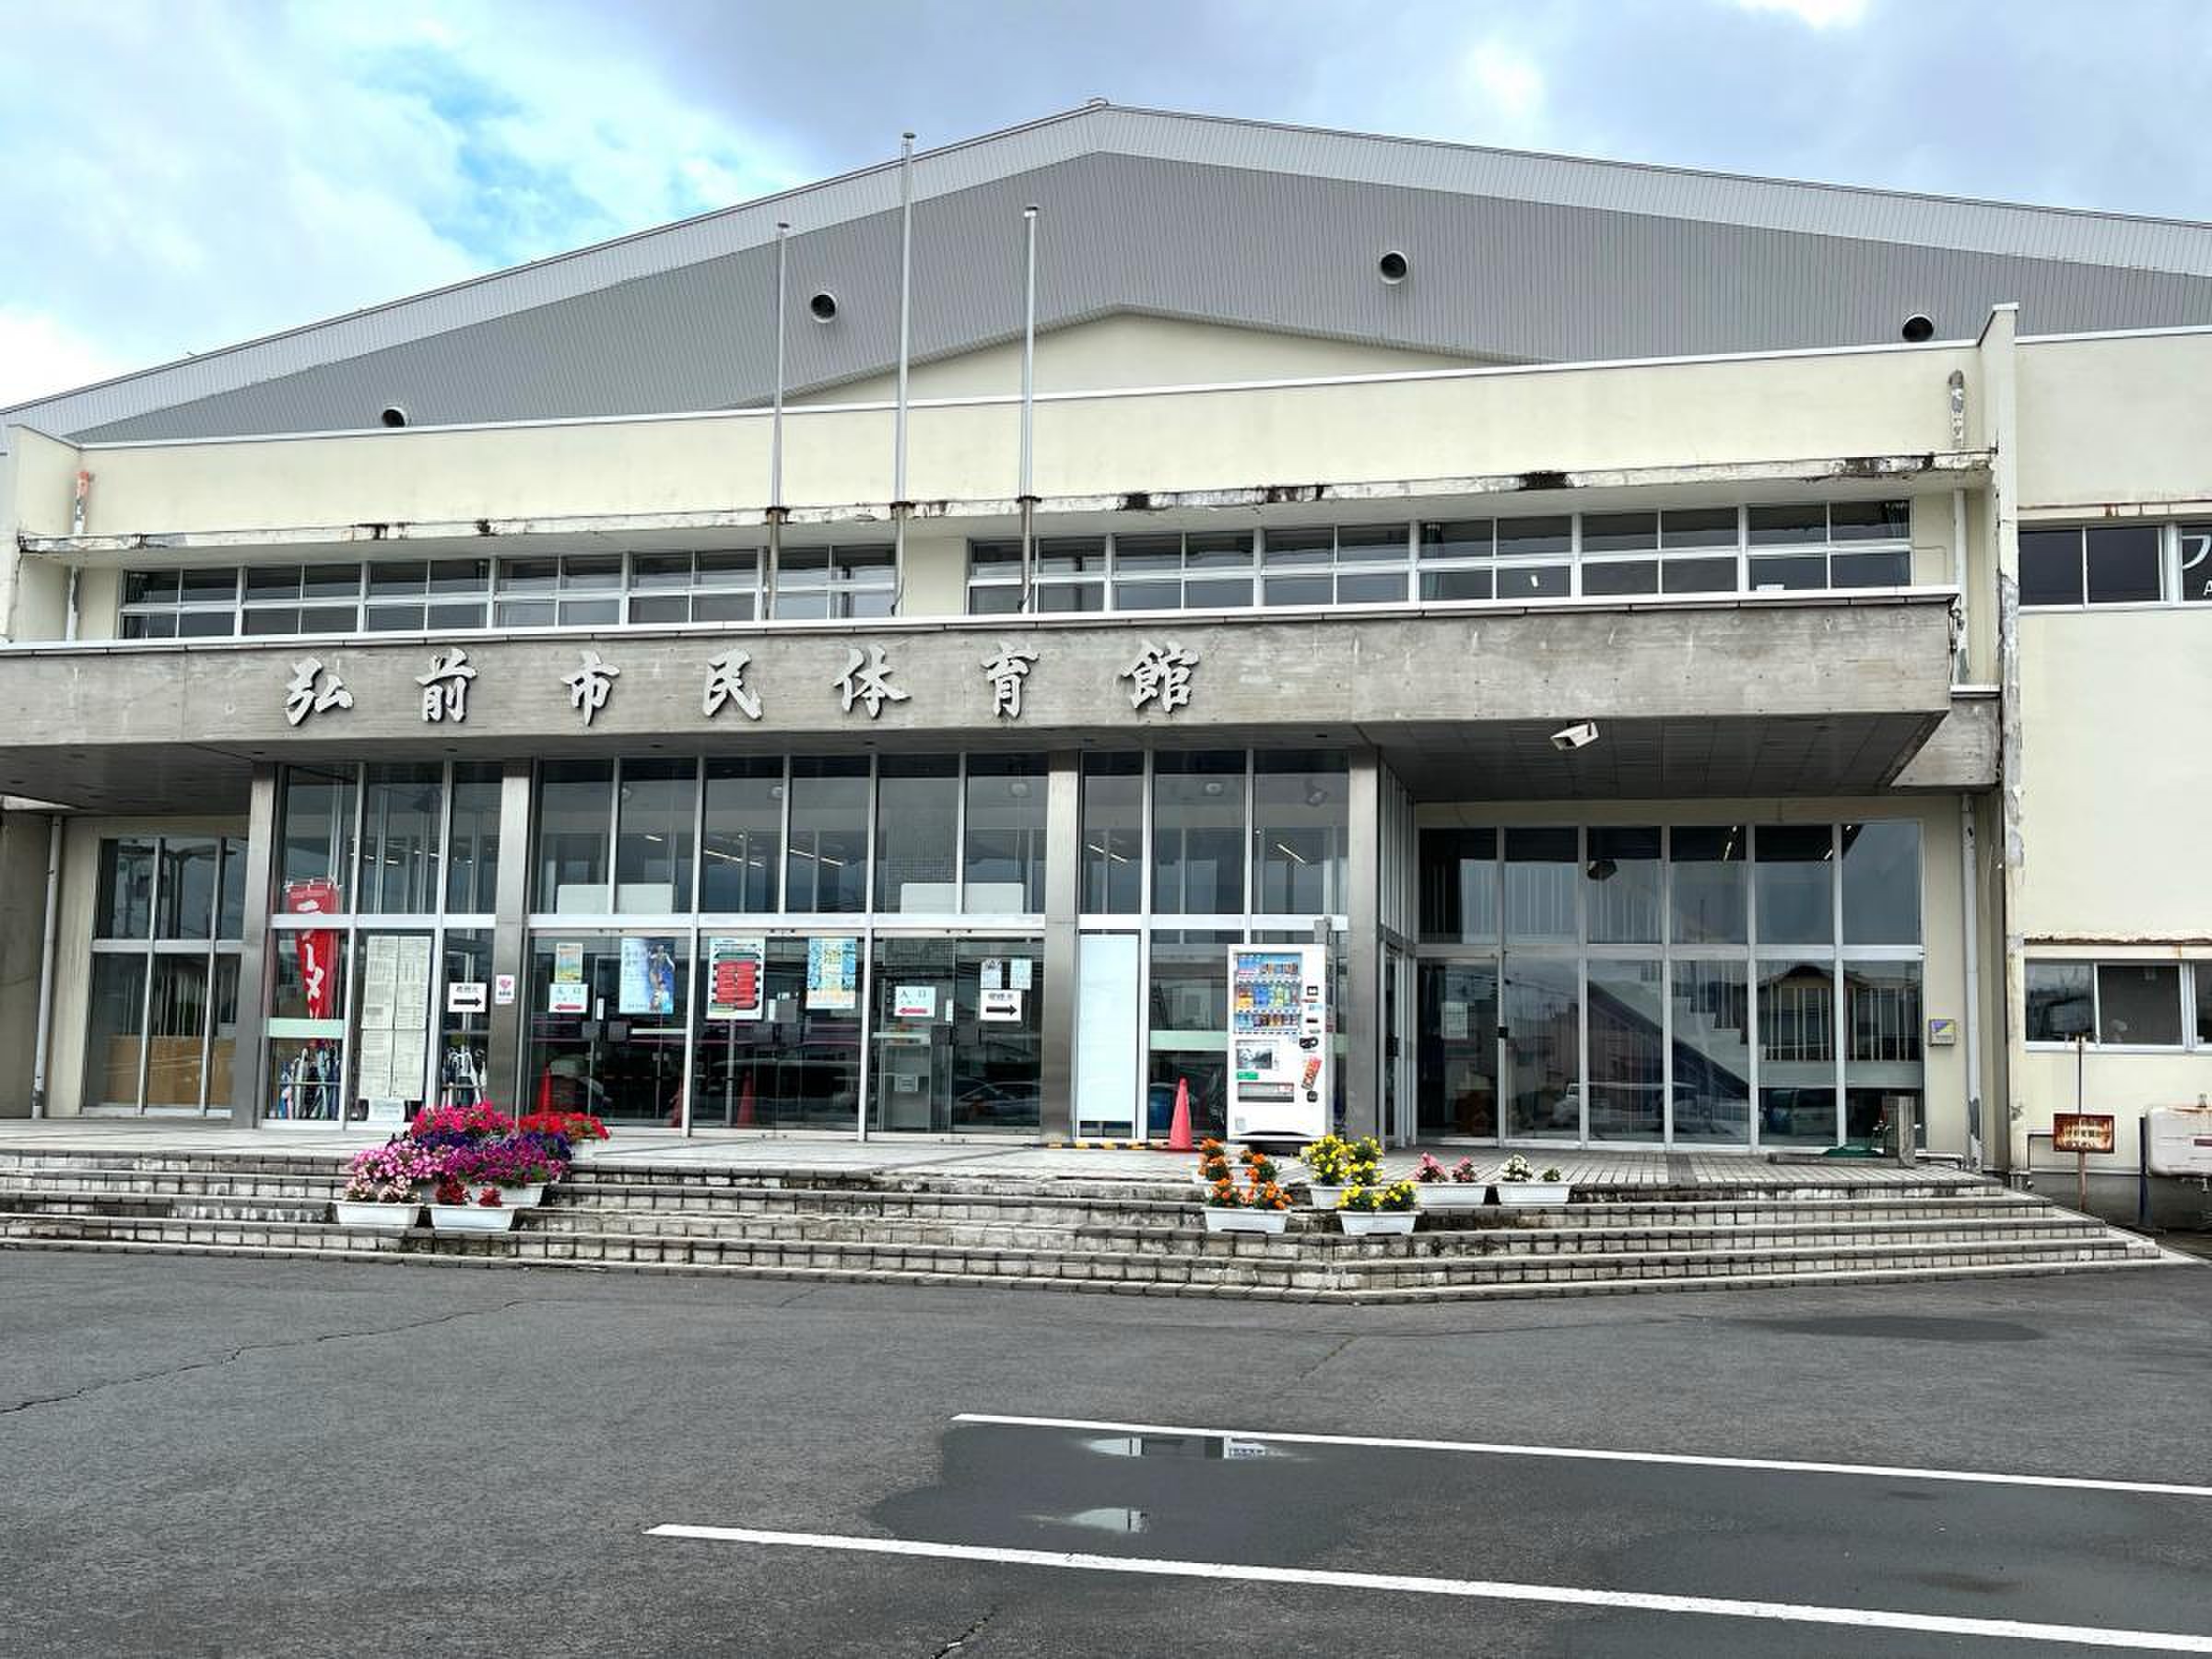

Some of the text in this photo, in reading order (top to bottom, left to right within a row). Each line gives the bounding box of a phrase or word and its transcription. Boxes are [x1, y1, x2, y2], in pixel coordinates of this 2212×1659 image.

[285, 640, 1200, 726] 弘前市民体育館
[296, 899, 325, 1019] ラーメ
